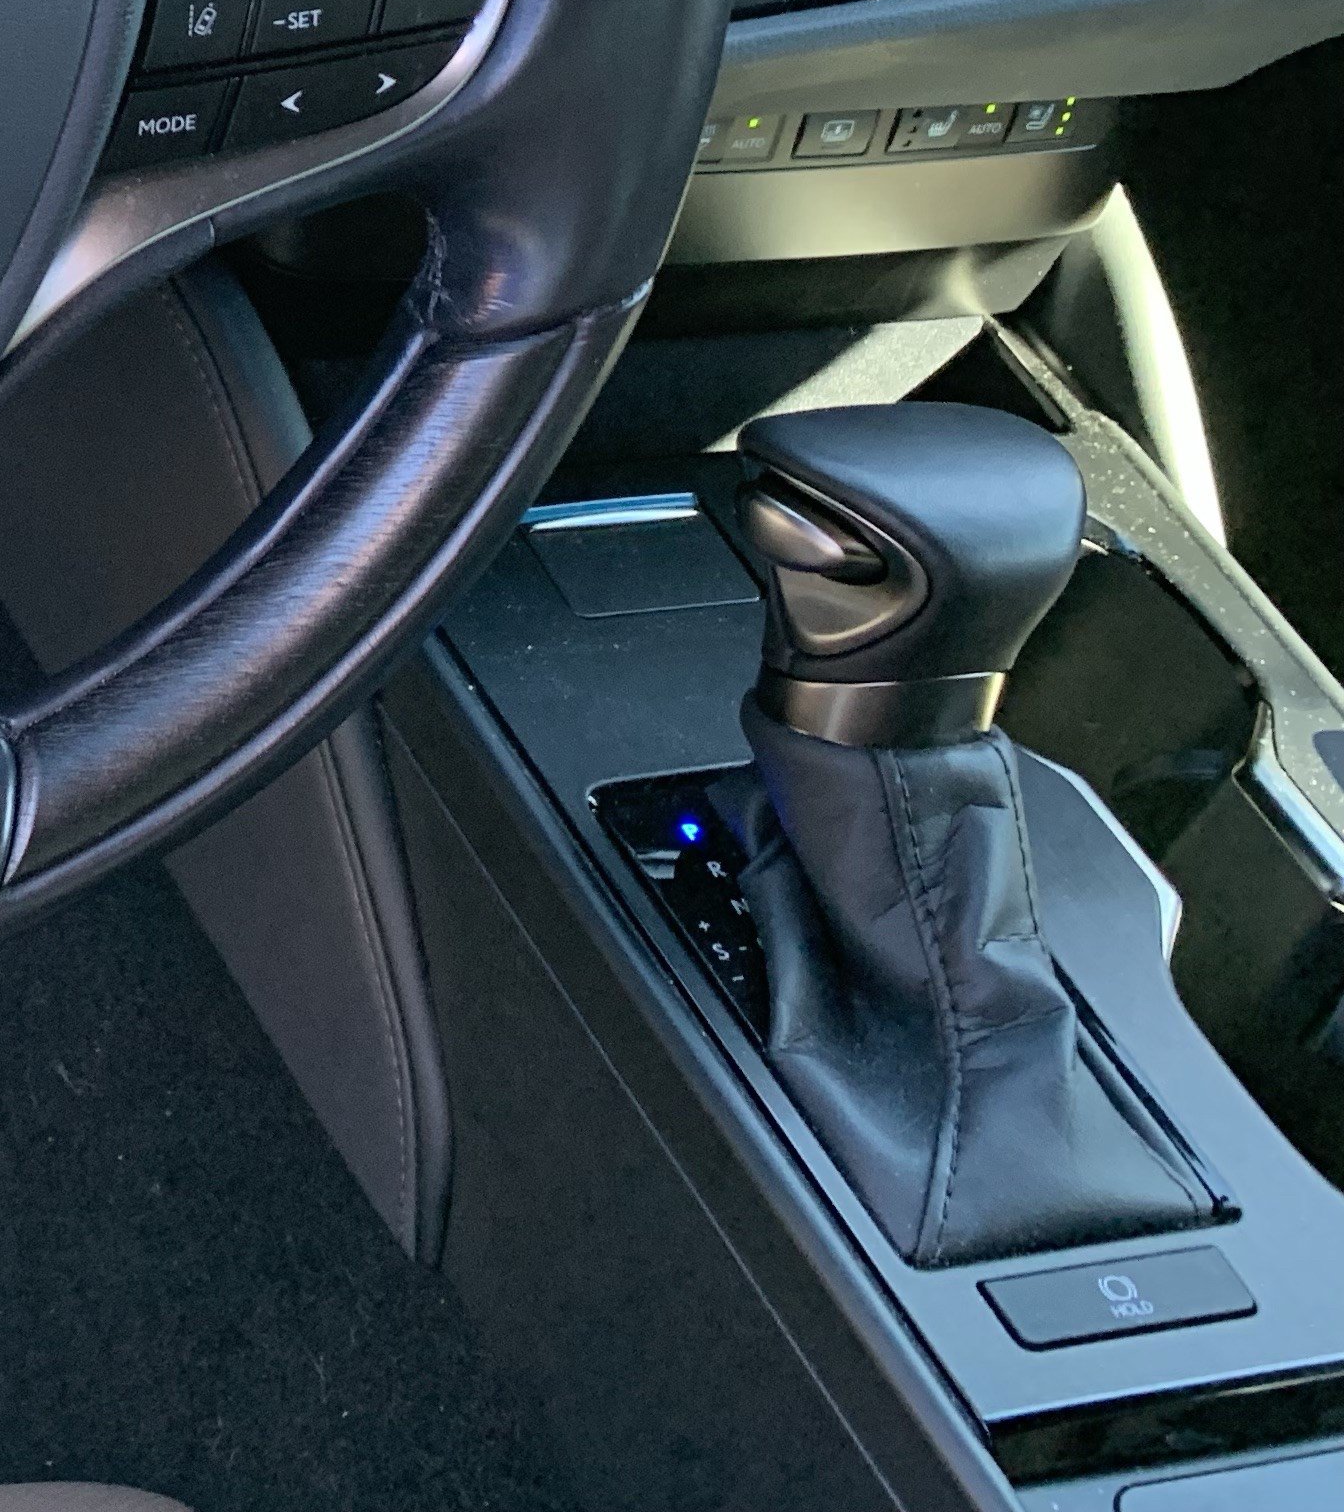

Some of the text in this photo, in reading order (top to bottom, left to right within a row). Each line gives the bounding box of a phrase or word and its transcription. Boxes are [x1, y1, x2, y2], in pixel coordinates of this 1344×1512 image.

[137, 114, 197, 136] MODE
[968, 122, 1003, 135] AUTO
[681, 823, 699, 841] P
[706, 860, 728, 878] R
[730, 898, 750, 915] N
[712, 942, 730, 961] S
[1112, 1300, 1154, 1318] HOLD
